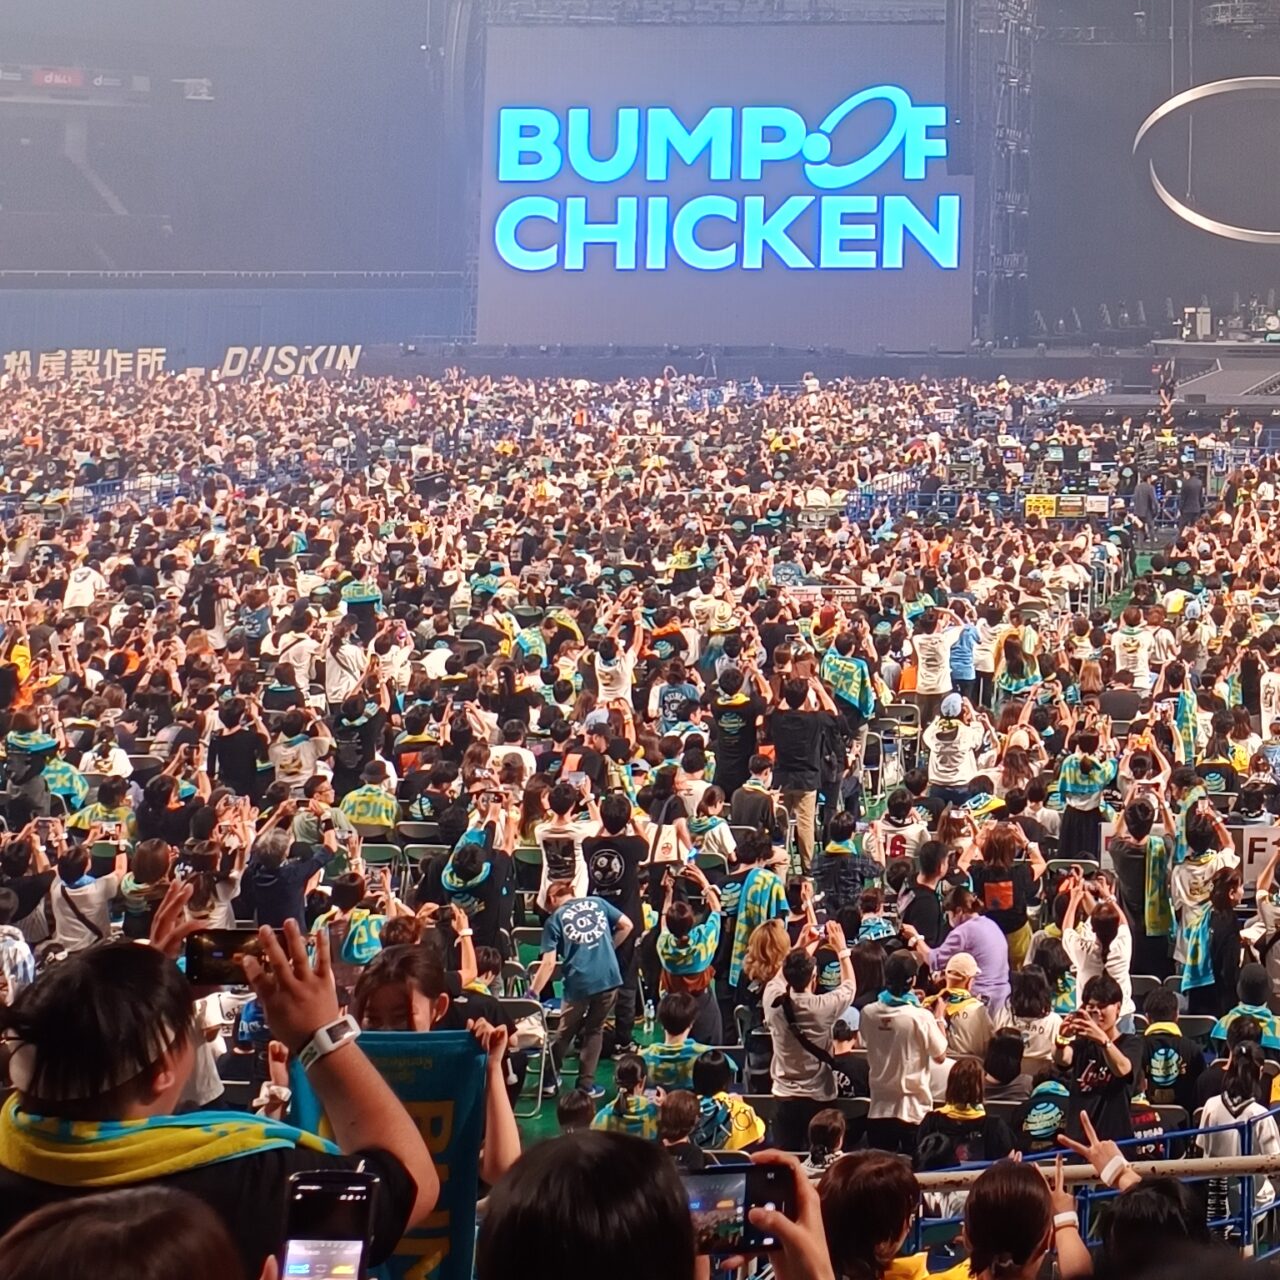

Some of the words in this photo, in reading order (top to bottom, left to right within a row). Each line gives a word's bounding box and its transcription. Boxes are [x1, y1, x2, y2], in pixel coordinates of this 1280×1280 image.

[498, 106, 807, 183] BUMP
[803, 84, 948, 189] OF
[494, 194, 961, 272] CHICKEN
[222, 345, 362, 377] DUSKIN
